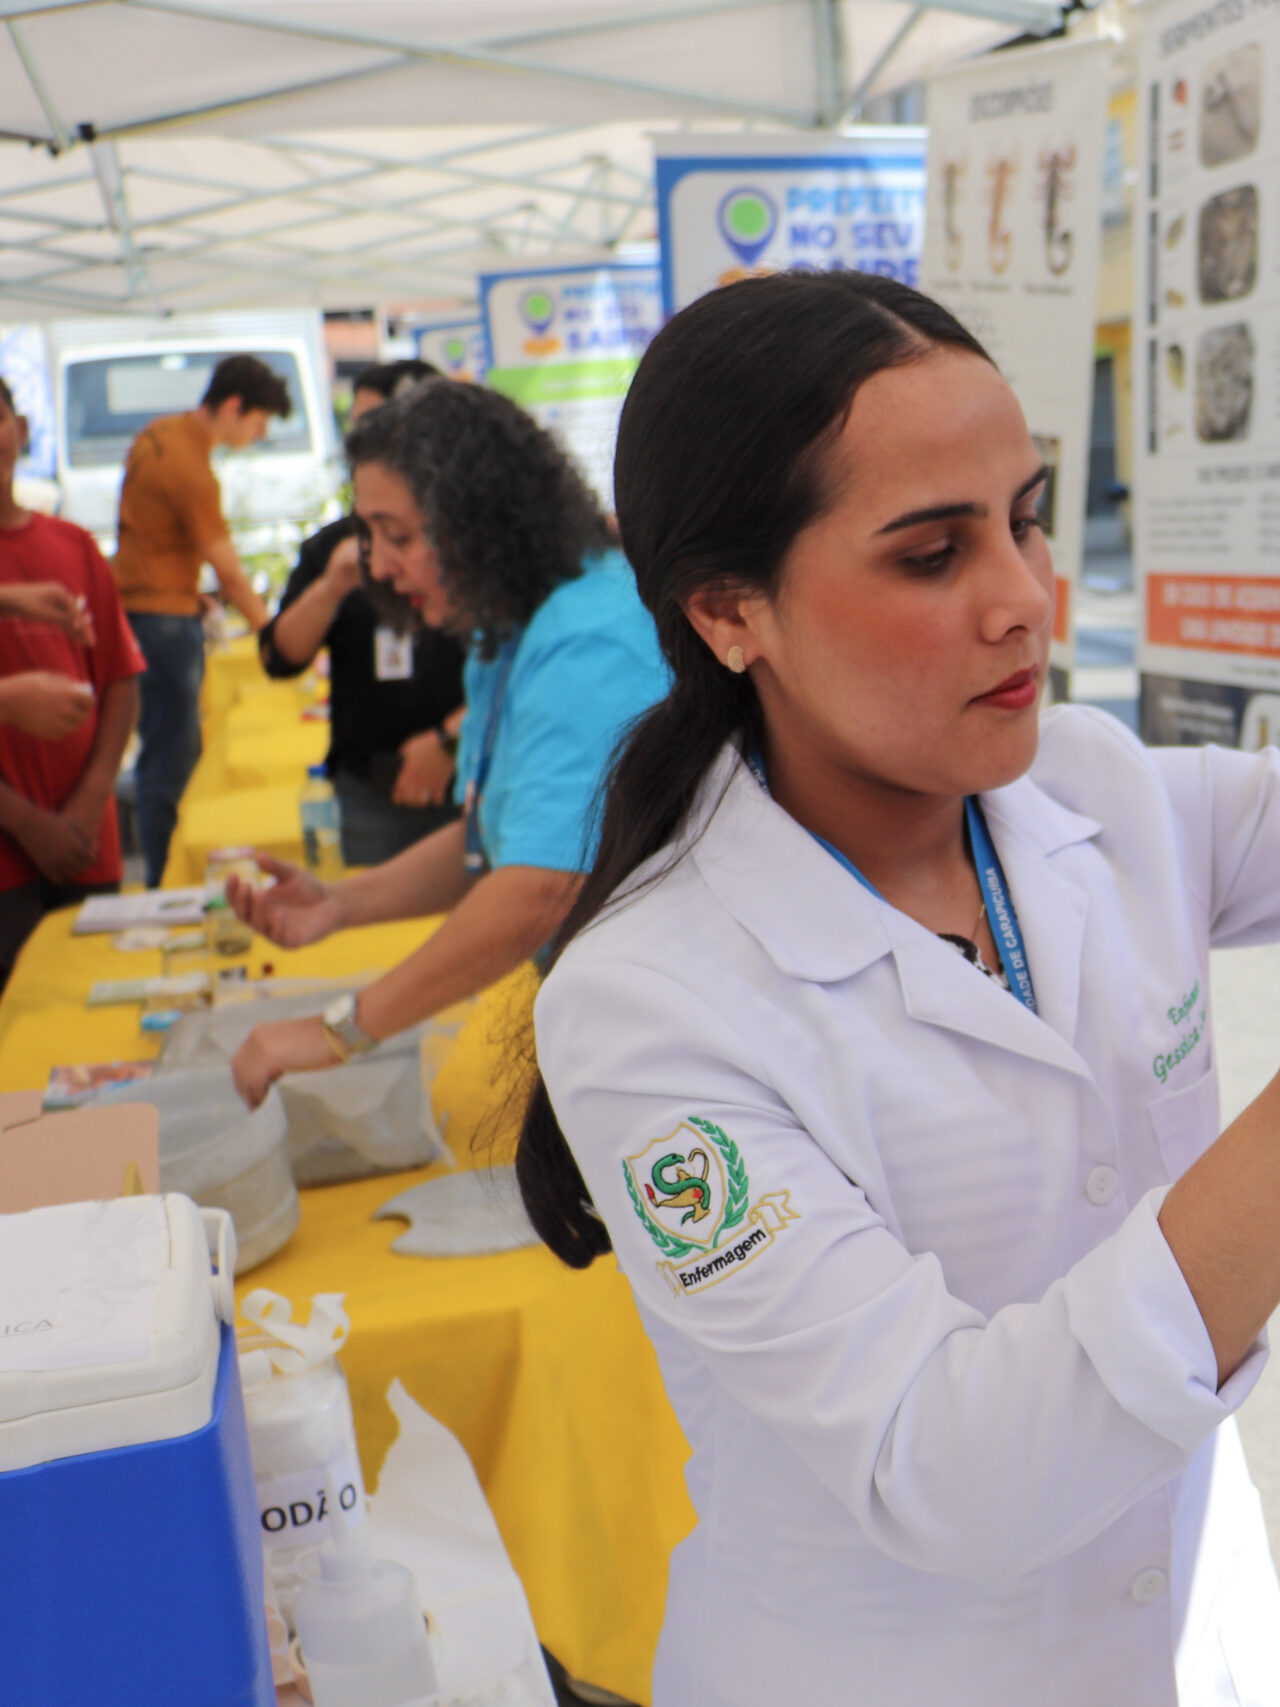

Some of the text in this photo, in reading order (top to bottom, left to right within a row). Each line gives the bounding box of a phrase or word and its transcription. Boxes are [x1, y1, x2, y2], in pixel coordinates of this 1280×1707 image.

[790, 222, 914, 248] NO SEU
[985, 867, 1019, 949] CARAPICUÍBA
[1009, 949, 1025, 969] DE
[679, 1227, 767, 1288] Enfermagem
